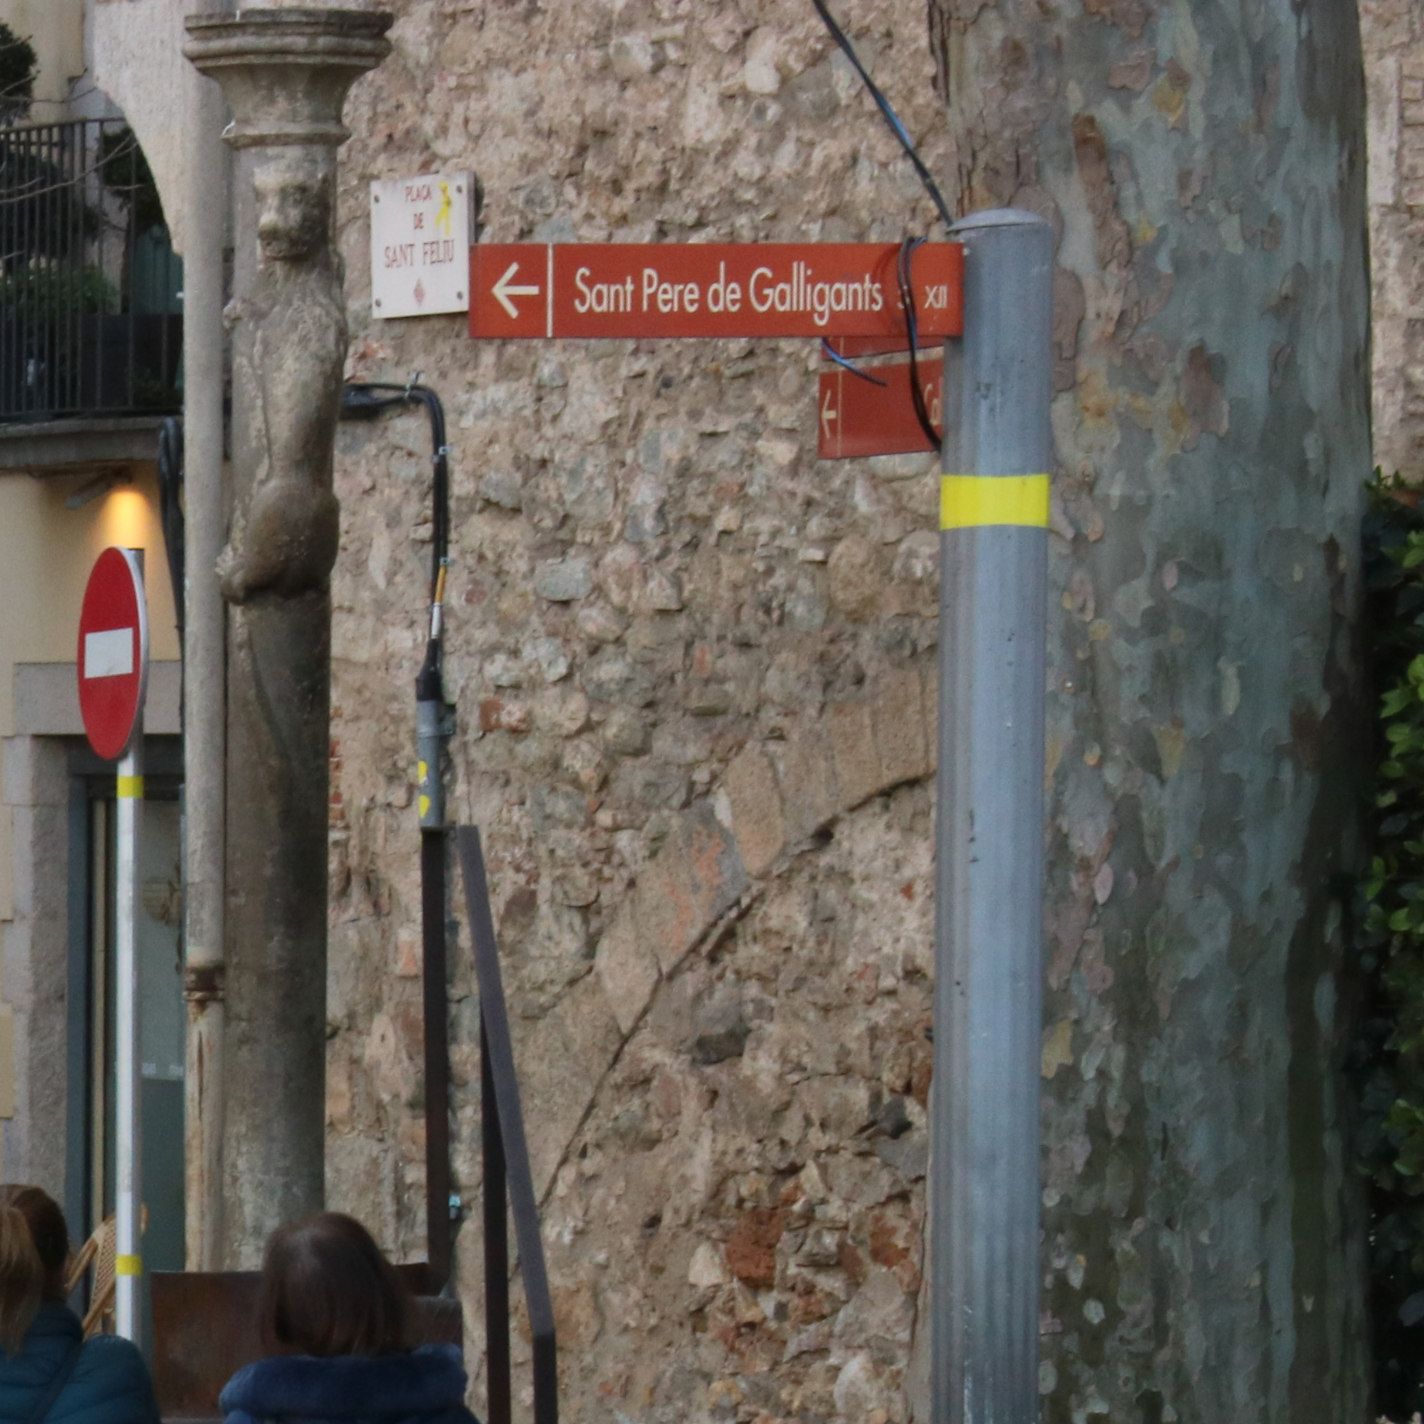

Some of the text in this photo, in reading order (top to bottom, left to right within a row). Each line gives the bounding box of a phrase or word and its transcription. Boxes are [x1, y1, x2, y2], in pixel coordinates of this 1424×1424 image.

[384, 239, 455, 268] SANT FELIU
[574, 266, 634, 314] Sant
[642, 267, 700, 314] Pere
[707, 261, 742, 313] de
[749, 260, 884, 327] Galligants
